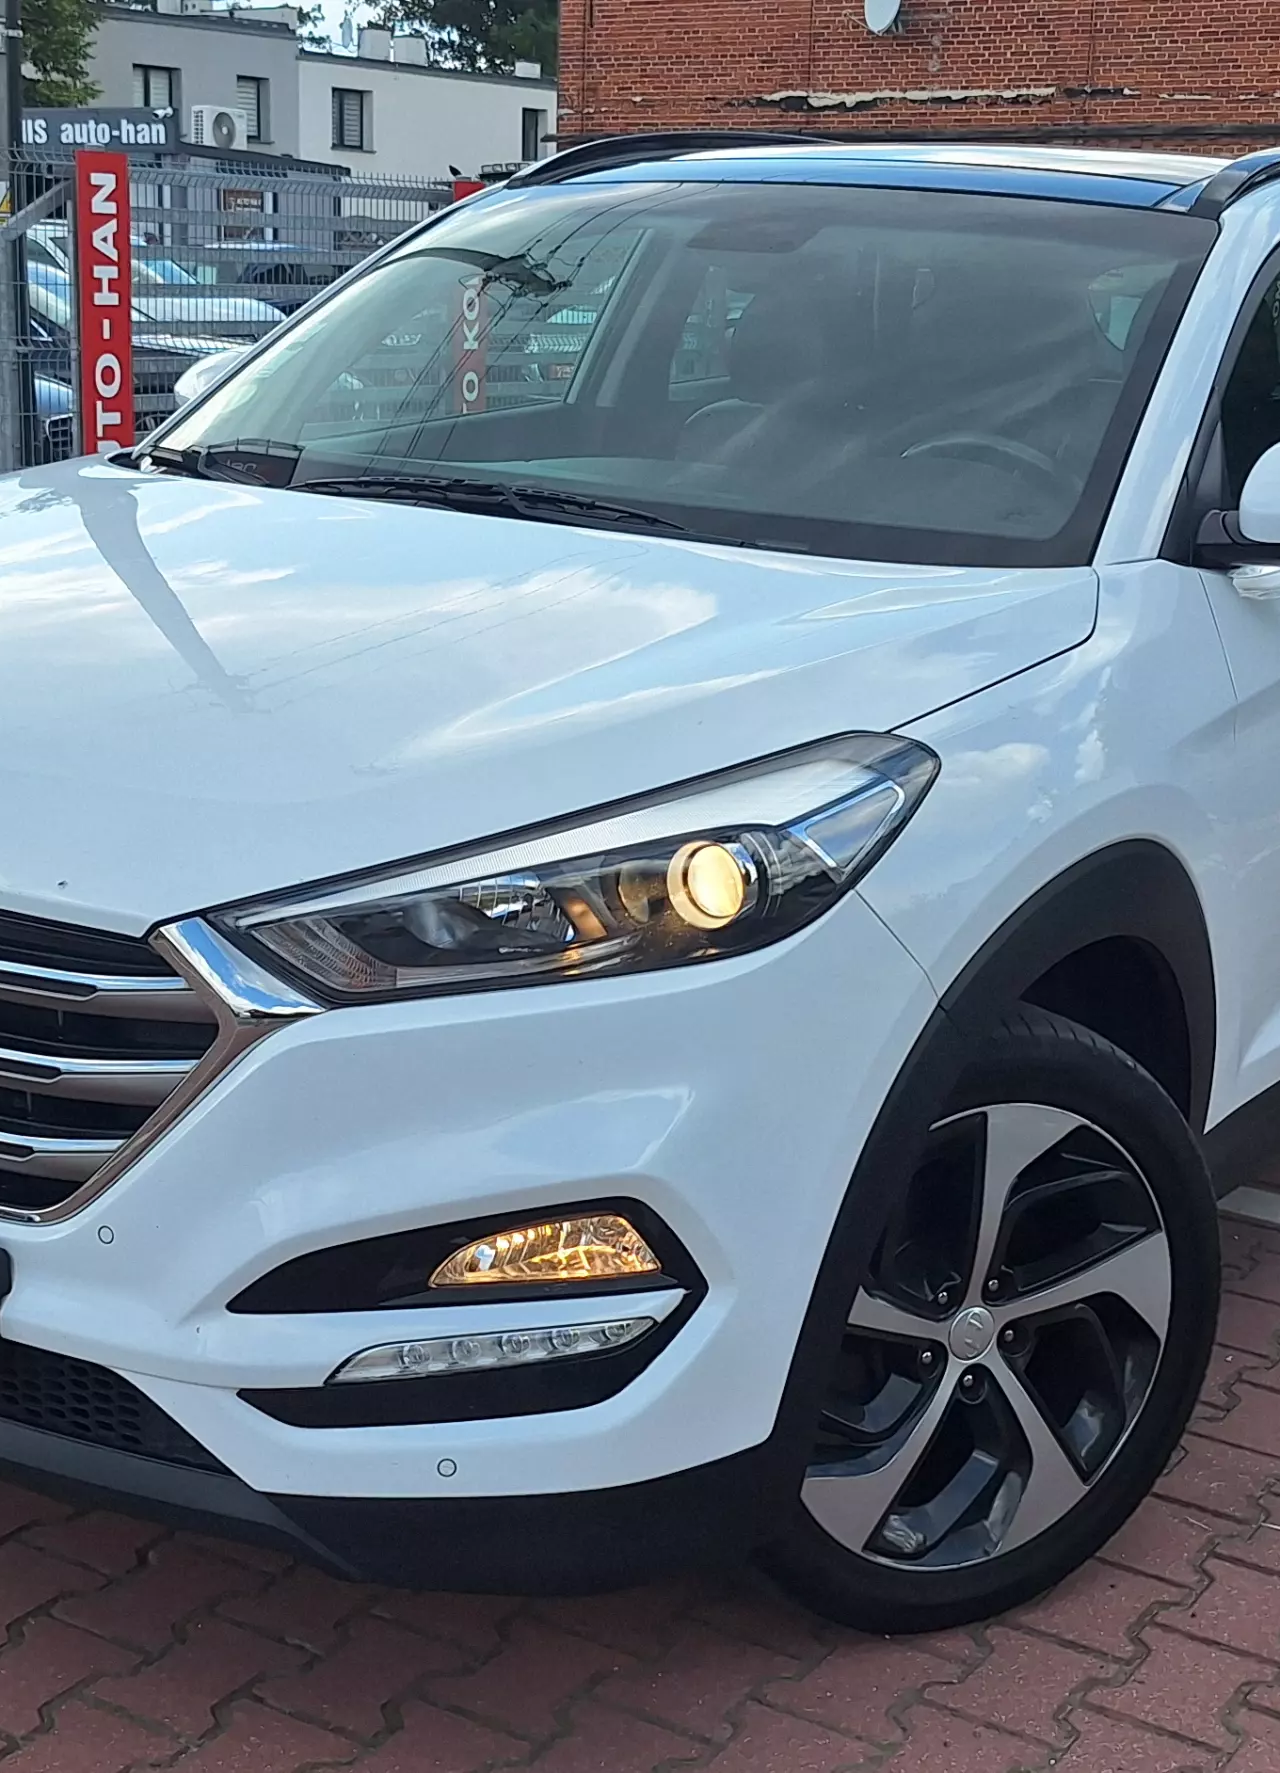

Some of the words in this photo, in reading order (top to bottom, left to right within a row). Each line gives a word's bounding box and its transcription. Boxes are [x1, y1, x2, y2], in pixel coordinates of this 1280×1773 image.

[60, 119, 166, 145] auto-han
[90, 172, 120, 306] HAN
[95, 353, 122, 453] TO
